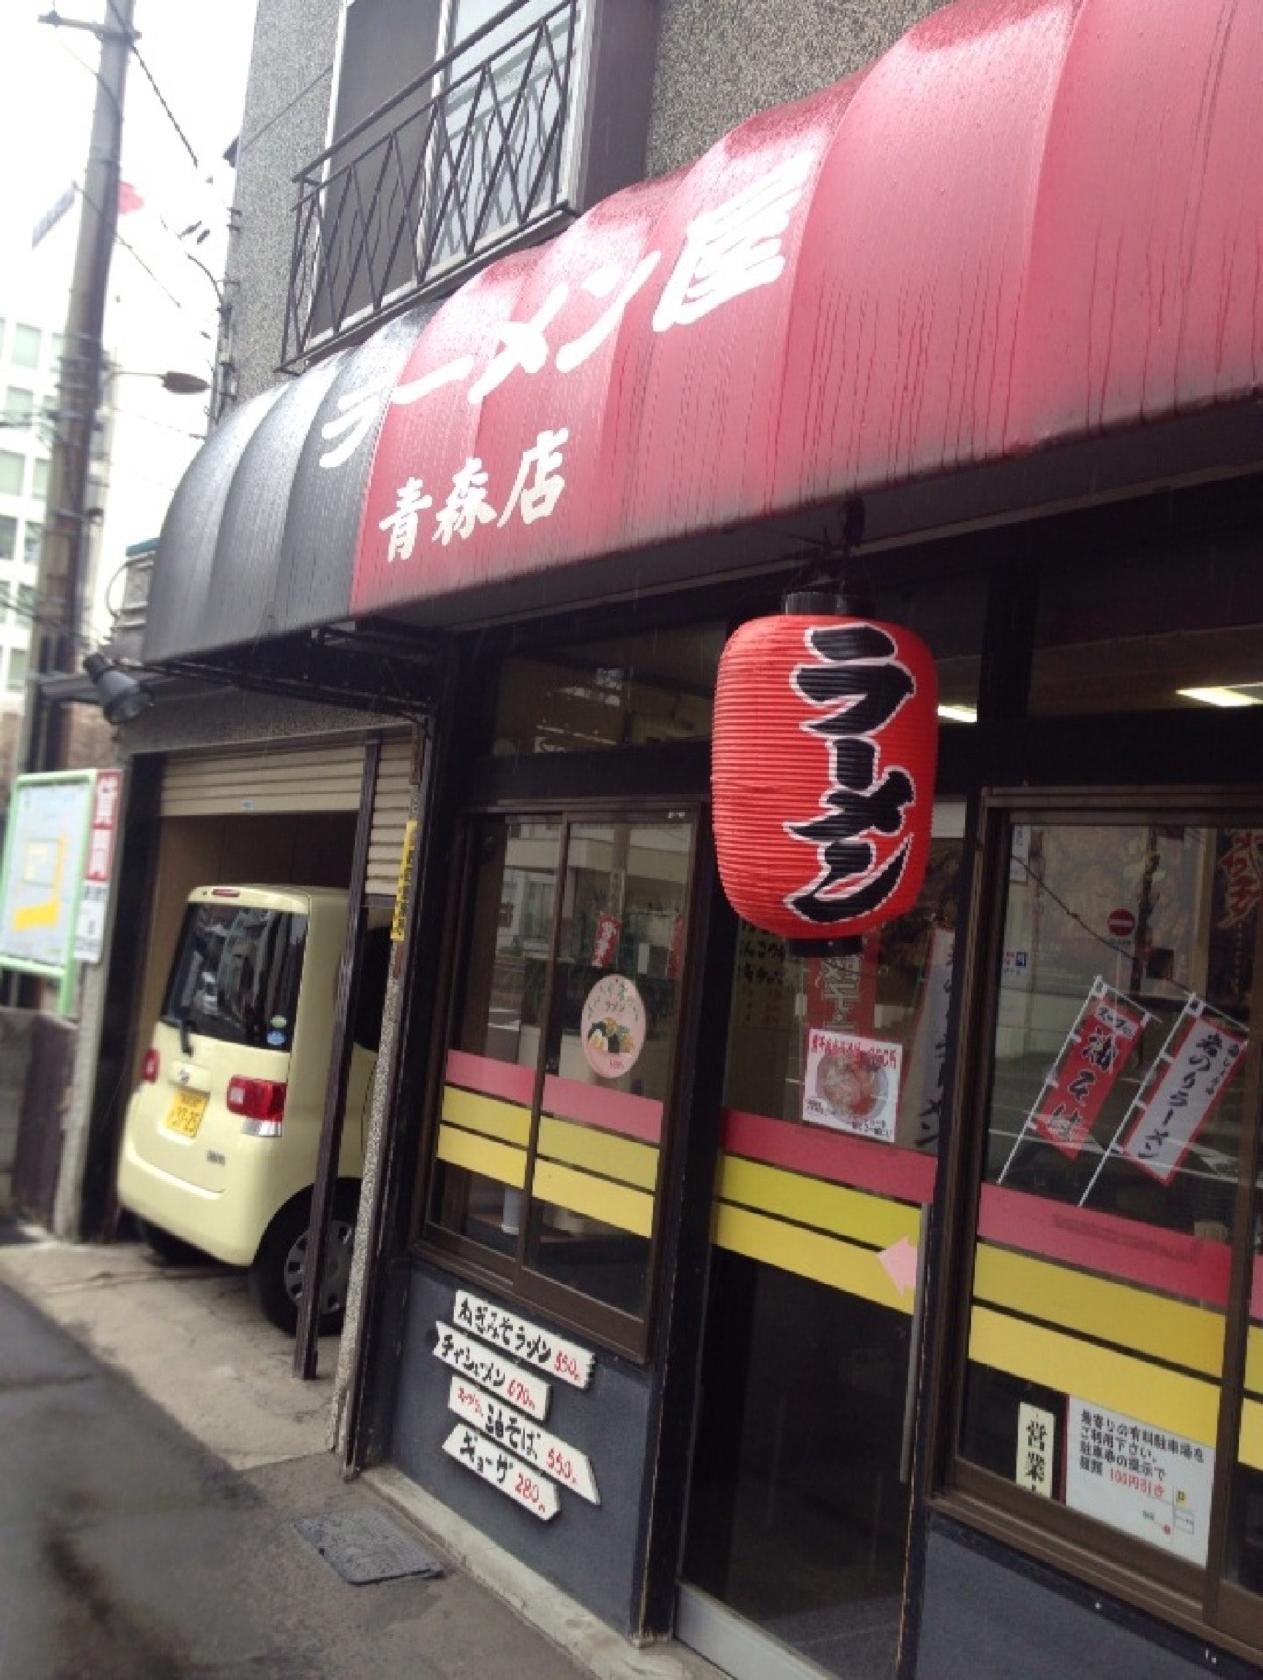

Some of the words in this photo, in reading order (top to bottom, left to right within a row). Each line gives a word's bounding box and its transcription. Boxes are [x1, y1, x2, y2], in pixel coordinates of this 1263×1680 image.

[320, 158, 812, 467] ラーメン屋
[379, 427, 569, 563] 青森店
[783, 622, 916, 924] ラーメン
[460, 1431, 514, 1483] ギョーザ
[1025, 1419, 1048, 1494] 営業
[1110, 1468, 1165, 1498] 100円引き
